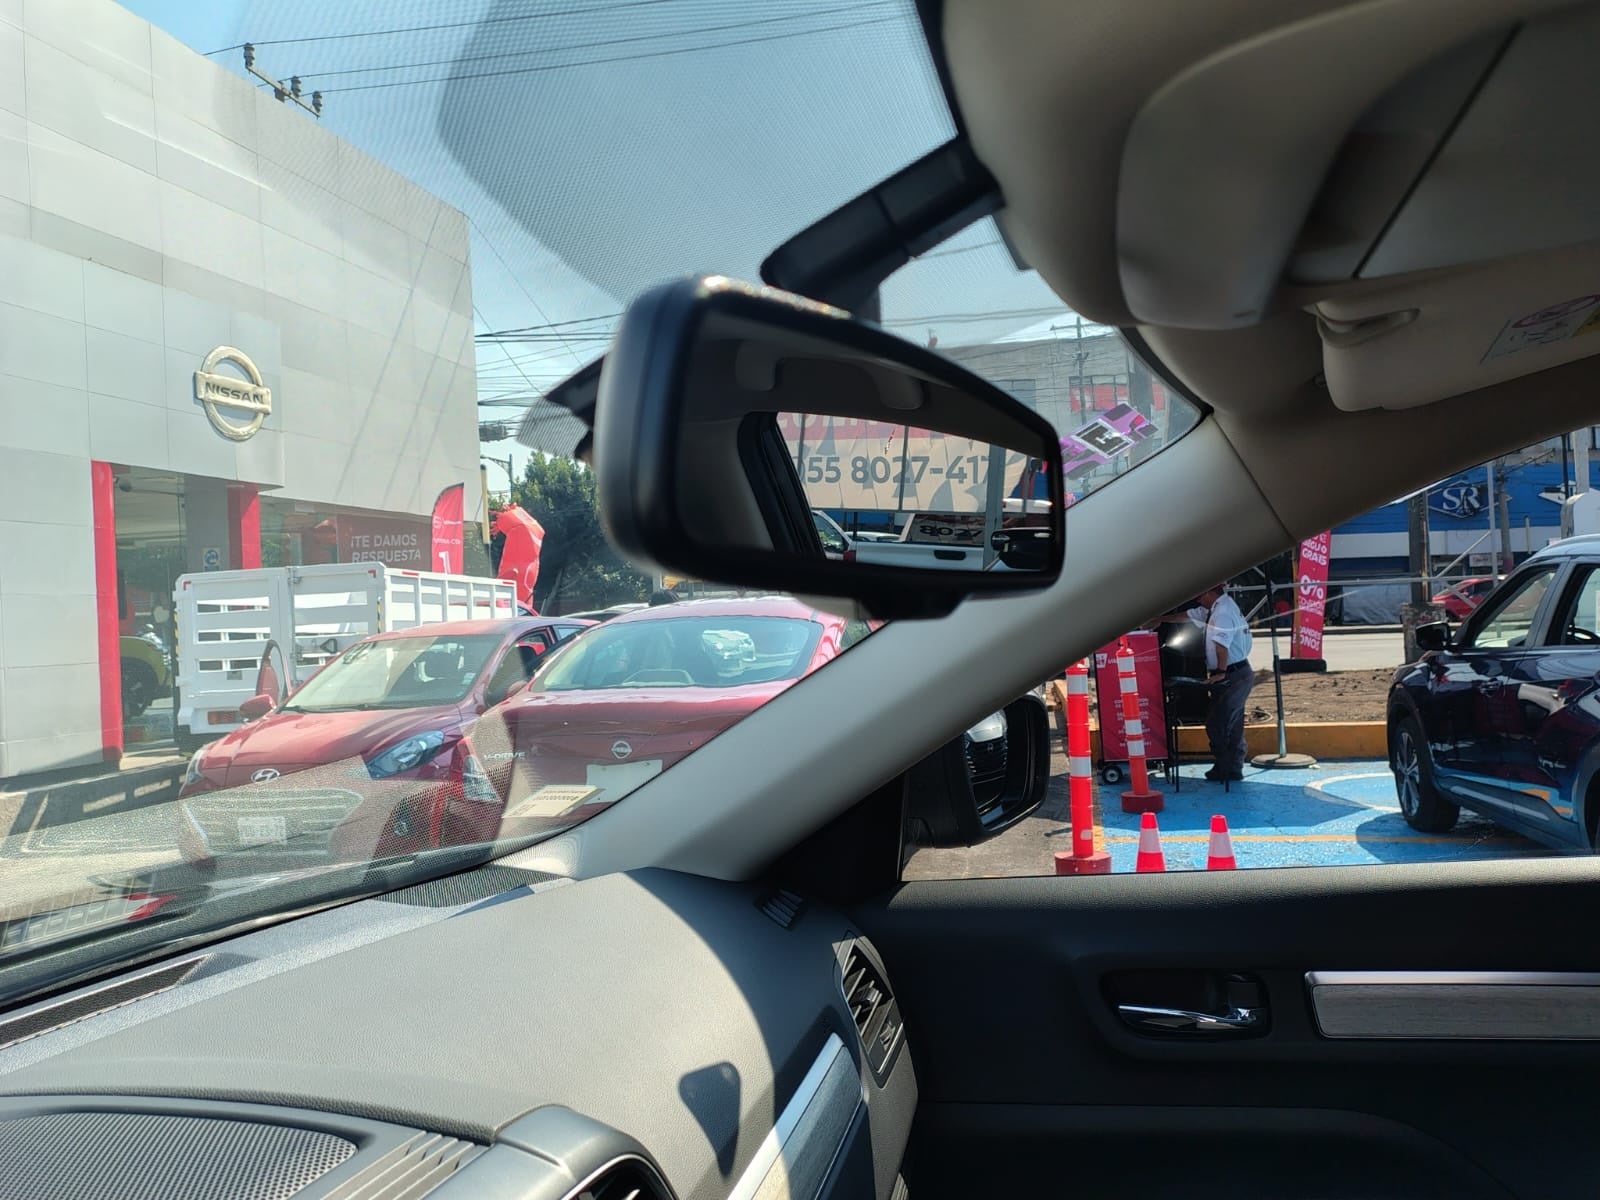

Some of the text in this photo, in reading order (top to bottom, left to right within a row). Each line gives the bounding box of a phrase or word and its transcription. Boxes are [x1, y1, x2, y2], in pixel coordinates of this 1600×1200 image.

[205, 381, 264, 404] NISSAN
[1442, 486, 1480, 509] SR
[374, 534, 417, 547] DAMOS
[352, 549, 422, 563] RESPUESTA
[1300, 574, 1324, 600] 0%
